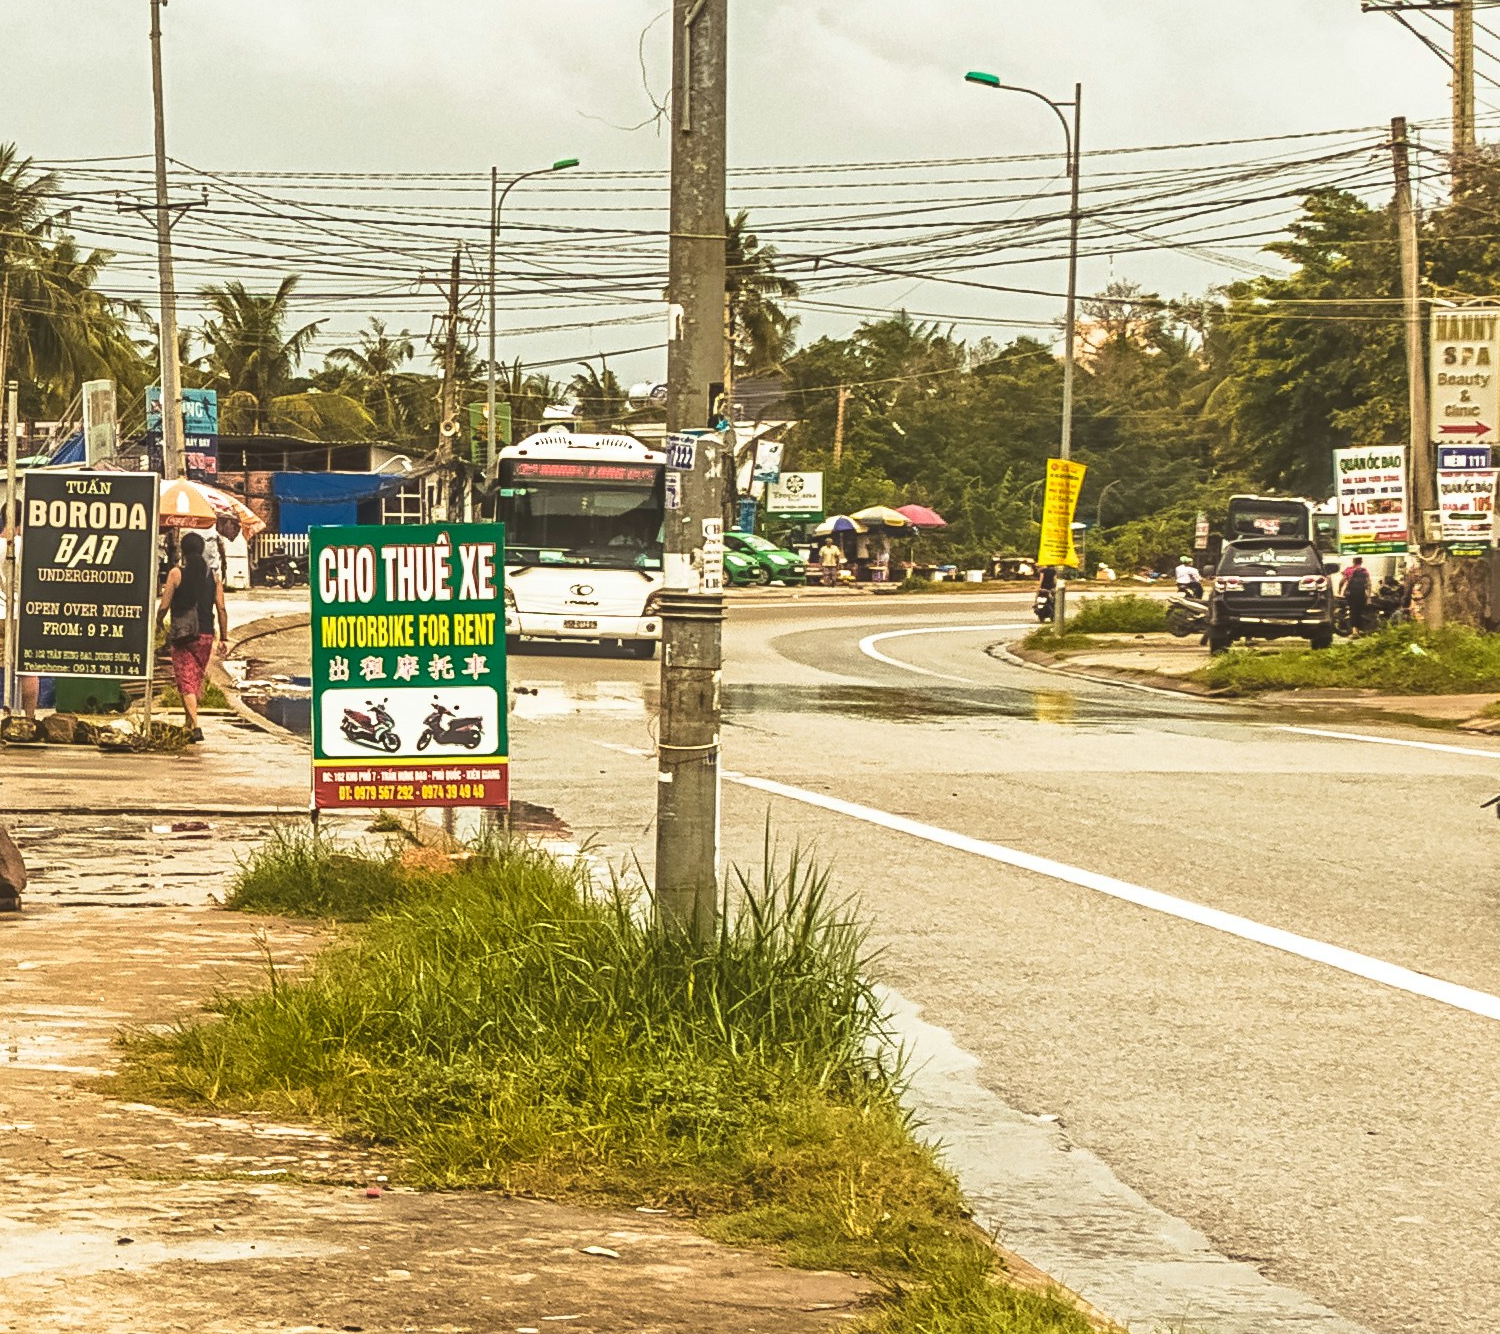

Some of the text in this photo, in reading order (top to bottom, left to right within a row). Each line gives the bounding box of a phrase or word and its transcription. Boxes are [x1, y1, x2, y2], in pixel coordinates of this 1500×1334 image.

[1444, 346, 1491, 366] SPA
[1437, 373, 1492, 388] Beauty
[1460, 389, 1471, 402] &
[1469, 455, 1486, 467] 111
[66, 478, 112, 495] TUẤN
[29, 500, 147, 530] BORODA
[54, 533, 119, 568] BAR
[318, 531, 497, 604] CHO THUÊ XE
[37, 568, 134, 584] UNDERGROUND
[25, 601, 142, 618] OPEN OVER NIGHT
[42, 622, 124, 638] FROM: 9 P.M
[321, 613, 496, 648] MOTORBIKE FOR RENT
[24, 662, 70, 672] Telephone:
[73, 663, 96, 673] 0913
[115, 665, 124, 674] 11
[128, 666, 140, 675] 44
[353, 785, 376, 800] 0979
[378, 785, 395, 800] 567
[397, 785, 414, 800] 292
[421, 784, 444, 799] 0974
[445, 784, 457, 799] 39
